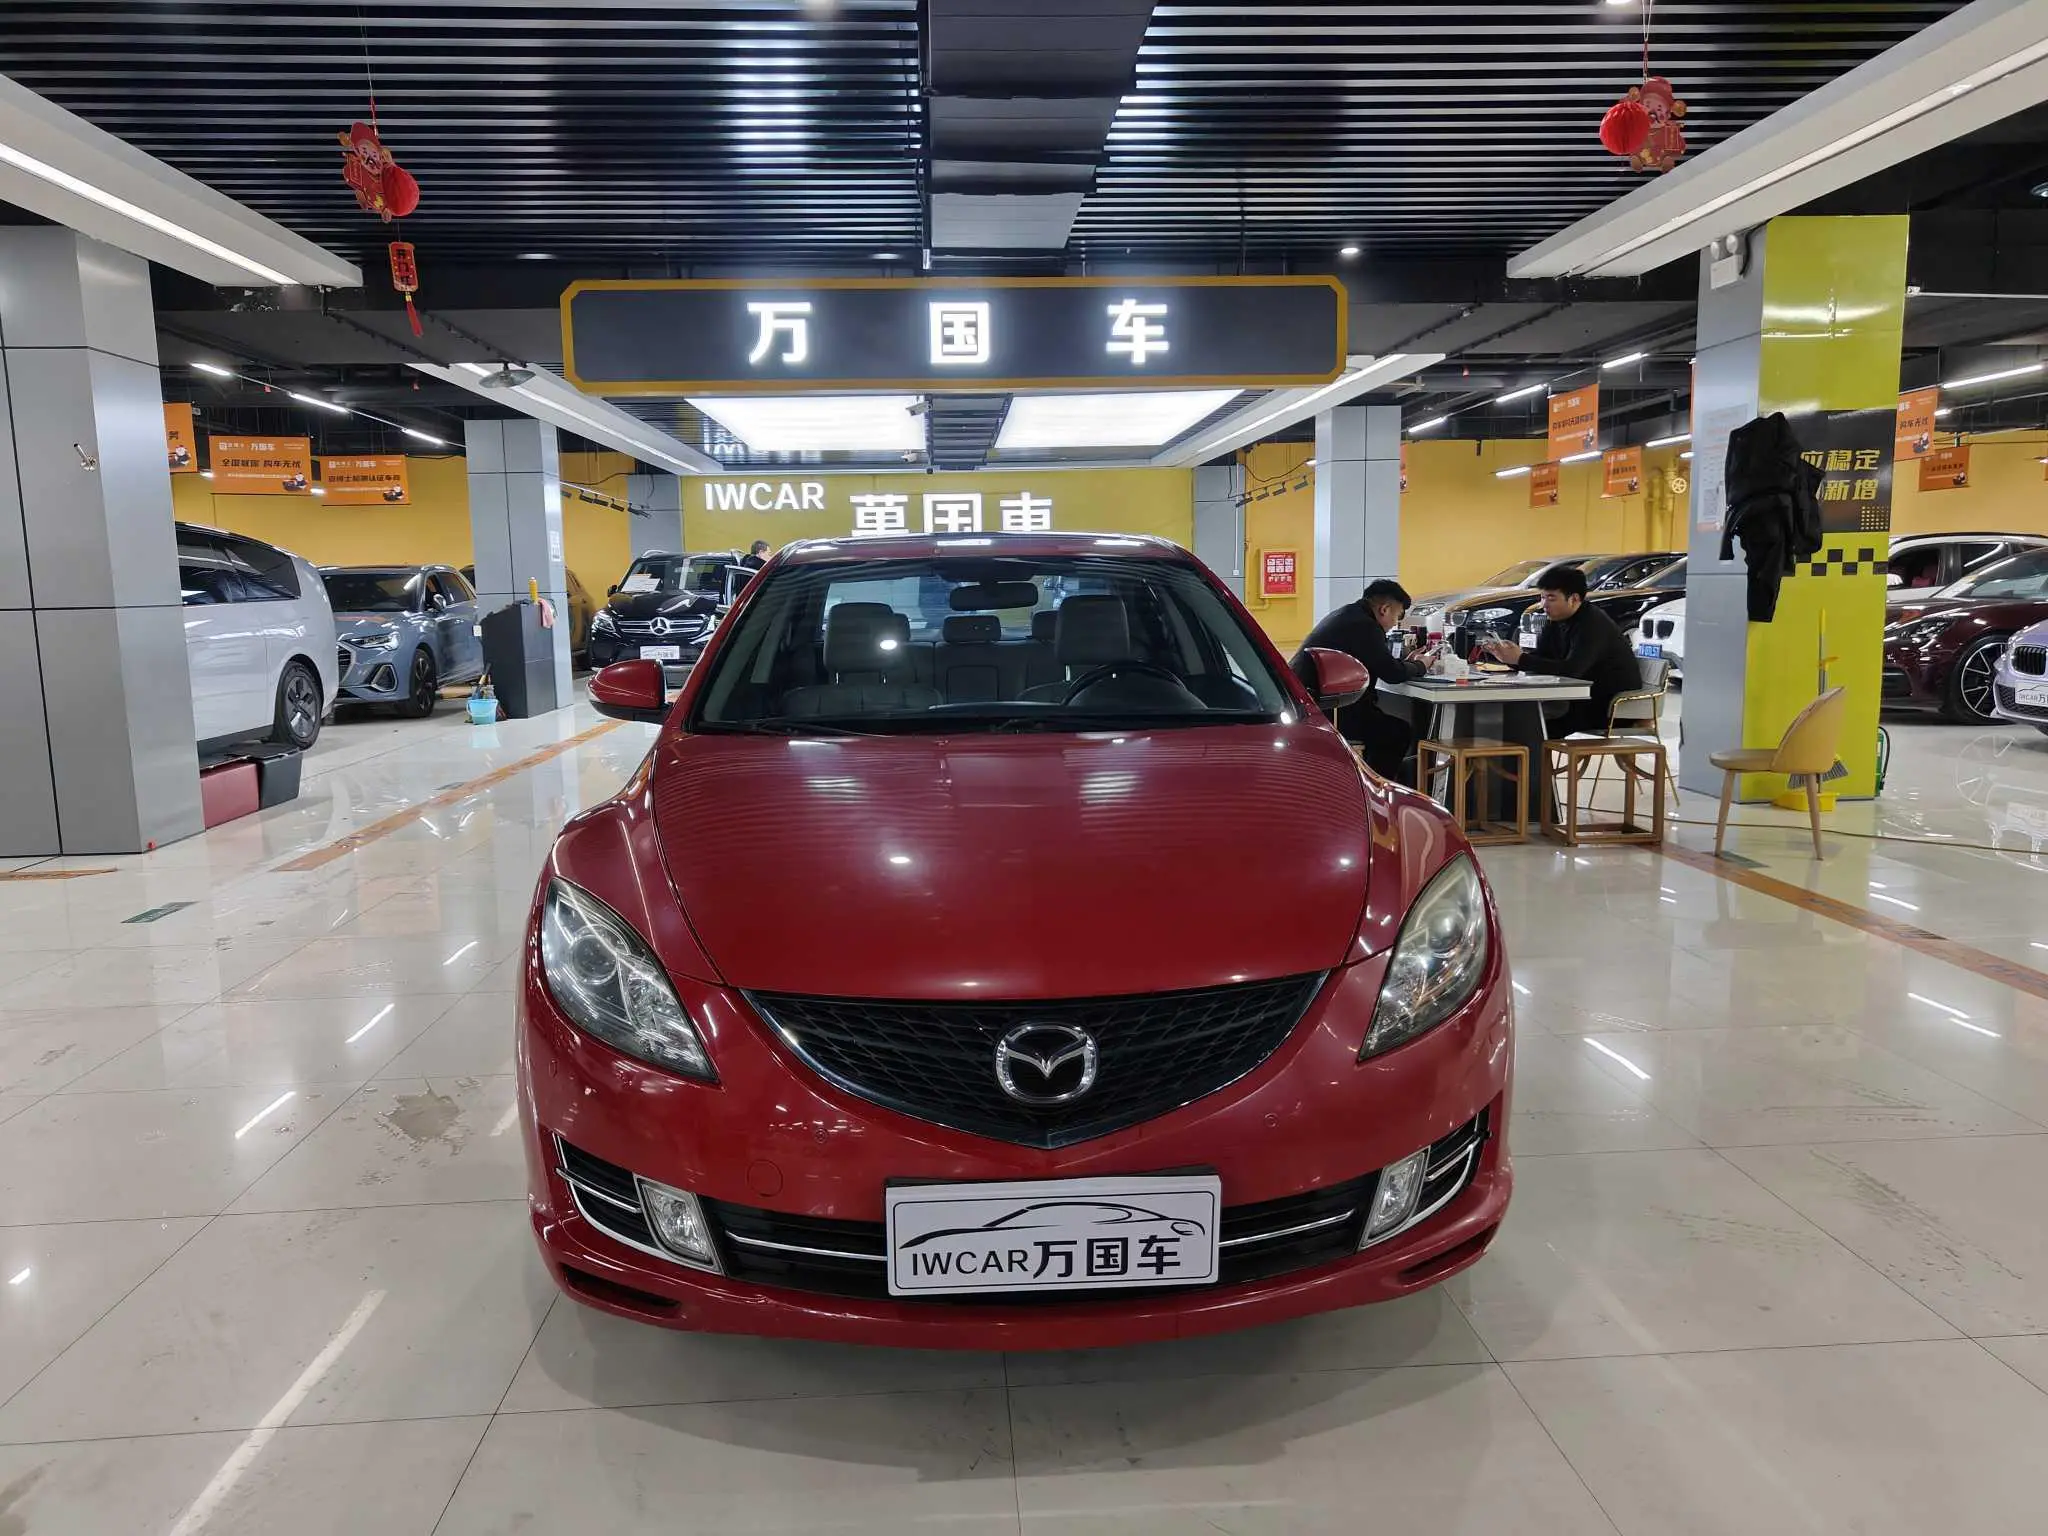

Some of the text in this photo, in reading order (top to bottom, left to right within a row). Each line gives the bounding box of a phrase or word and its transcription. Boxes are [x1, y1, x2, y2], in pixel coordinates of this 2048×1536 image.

[746, 299, 1169, 365] 万国车
[705, 482, 825, 511] IWCAR
[912, 1234, 1182, 1279] IWCAR万国车
